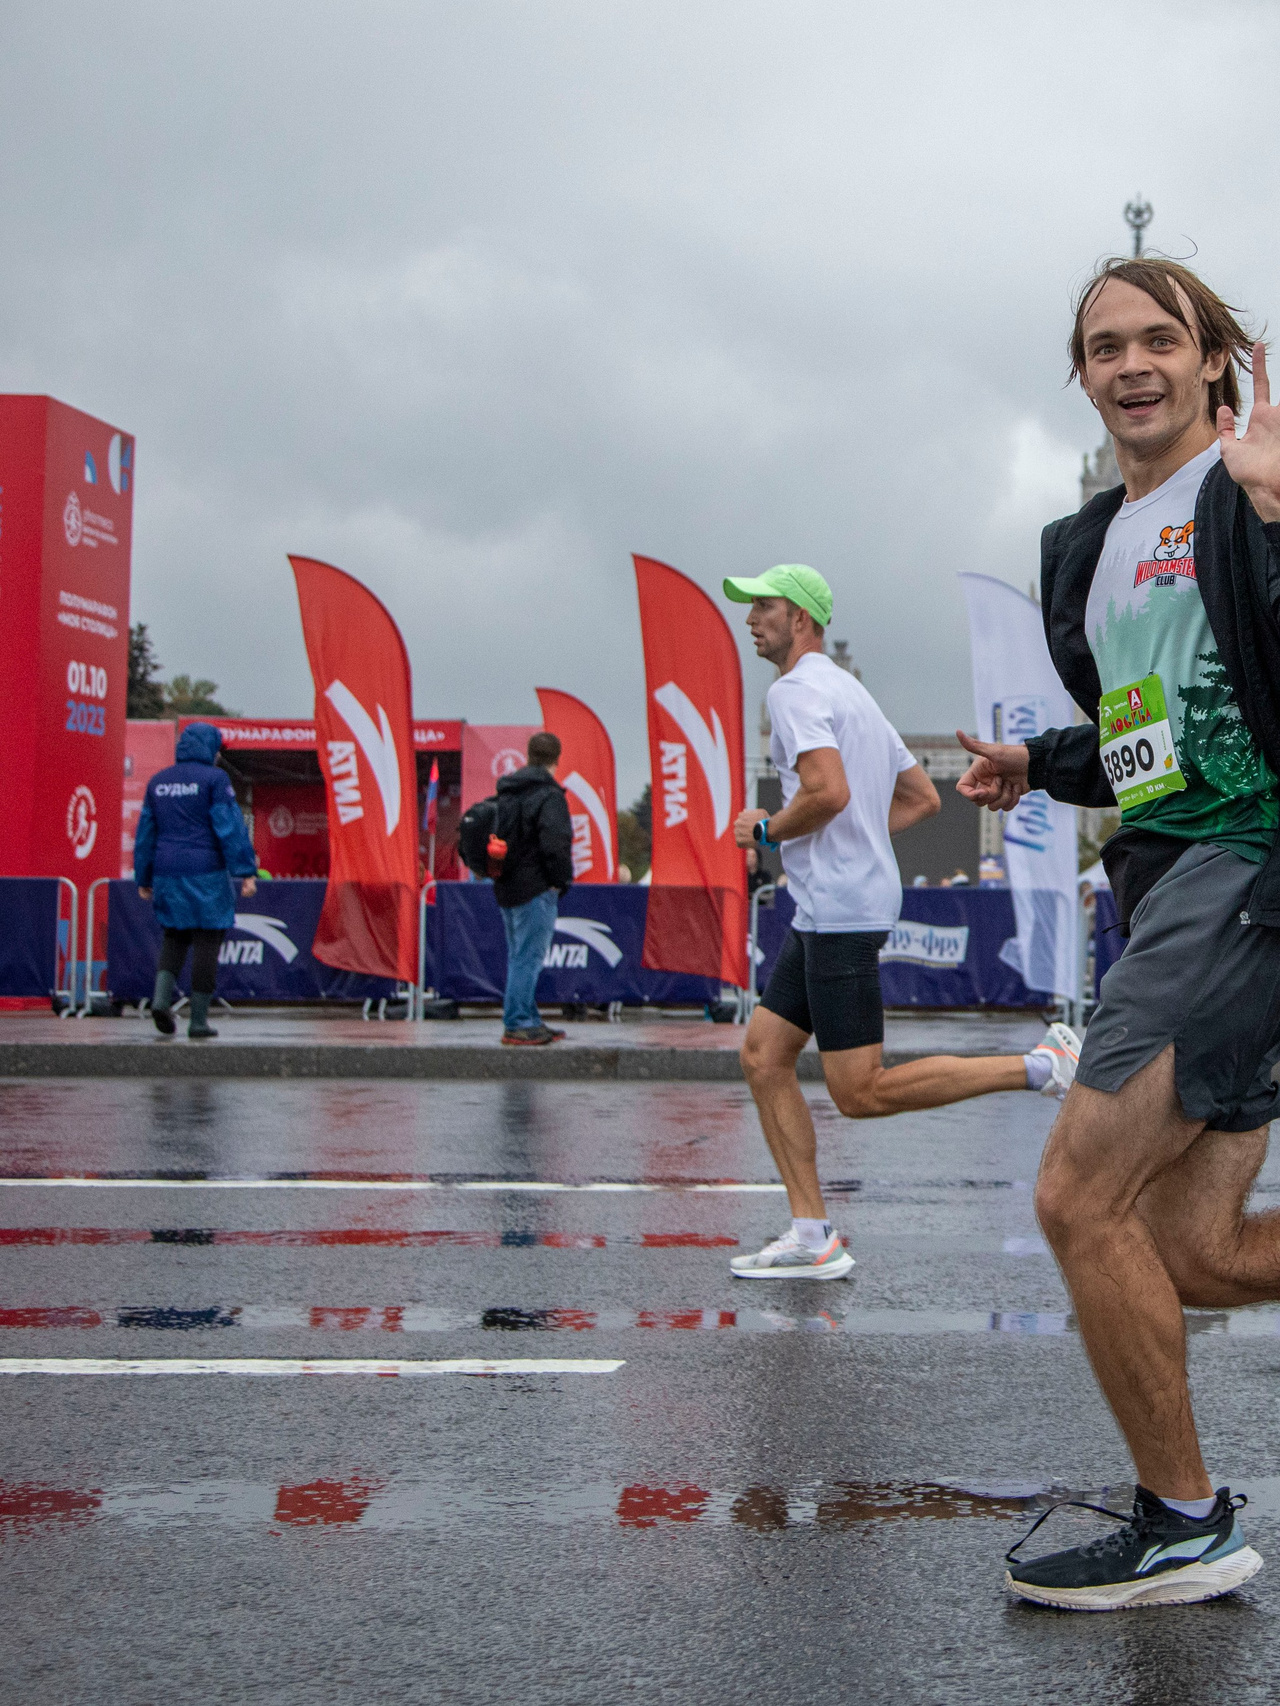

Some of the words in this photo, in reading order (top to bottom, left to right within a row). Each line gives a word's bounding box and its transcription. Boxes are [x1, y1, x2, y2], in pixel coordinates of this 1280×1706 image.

[1135, 560, 1157, 585] WILD
[1156, 575, 1175, 586] CLUB
[66, 659, 108, 699] 01.10
[65, 699, 106, 737] 2023
[155, 783, 199, 798] СУДЬЯ
[1146, 785, 1154, 794] 10
